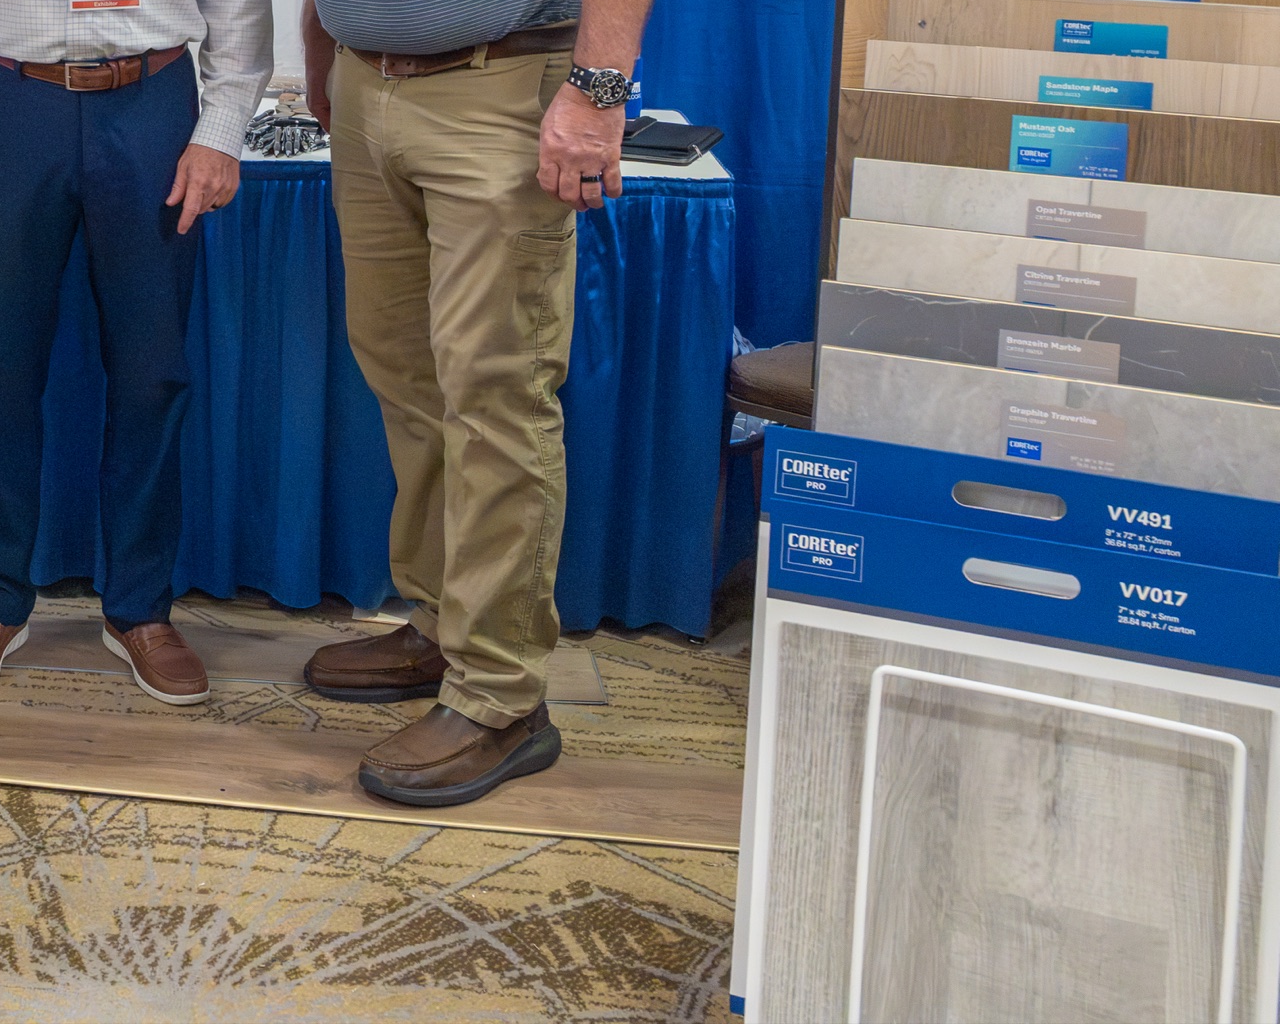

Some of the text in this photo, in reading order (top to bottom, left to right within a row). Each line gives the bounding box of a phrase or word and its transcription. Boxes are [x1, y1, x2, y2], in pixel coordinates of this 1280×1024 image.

[1046, 81, 1119, 93] Sandstone Maple
[1019, 122, 1076, 133] Mustang Oak
[1020, 149, 1050, 158] COREtec
[1036, 206, 1056, 215] Opal
[1059, 208, 1102, 220] Travertine
[1025, 271, 1054, 281] Citrine
[1056, 274, 1101, 286] Travertine
[1051, 342, 1081, 353] Marble
[1010, 406, 1049, 418] Graphite
[1051, 411, 1097, 426] Travertine
[1009, 440, 1039, 451] COREtec
[782, 458, 850, 482] COREtec
[806, 480, 827, 491] PRO
[1107, 505, 1173, 530] VV491
[788, 532, 857, 557] COREtec
[1153, 547, 1181, 557] carton
[812, 556, 833, 566] PRO
[1120, 581, 1188, 607] VV017
[1158, 613, 1180, 623] 5mm
[1168, 624, 1196, 636] carton
